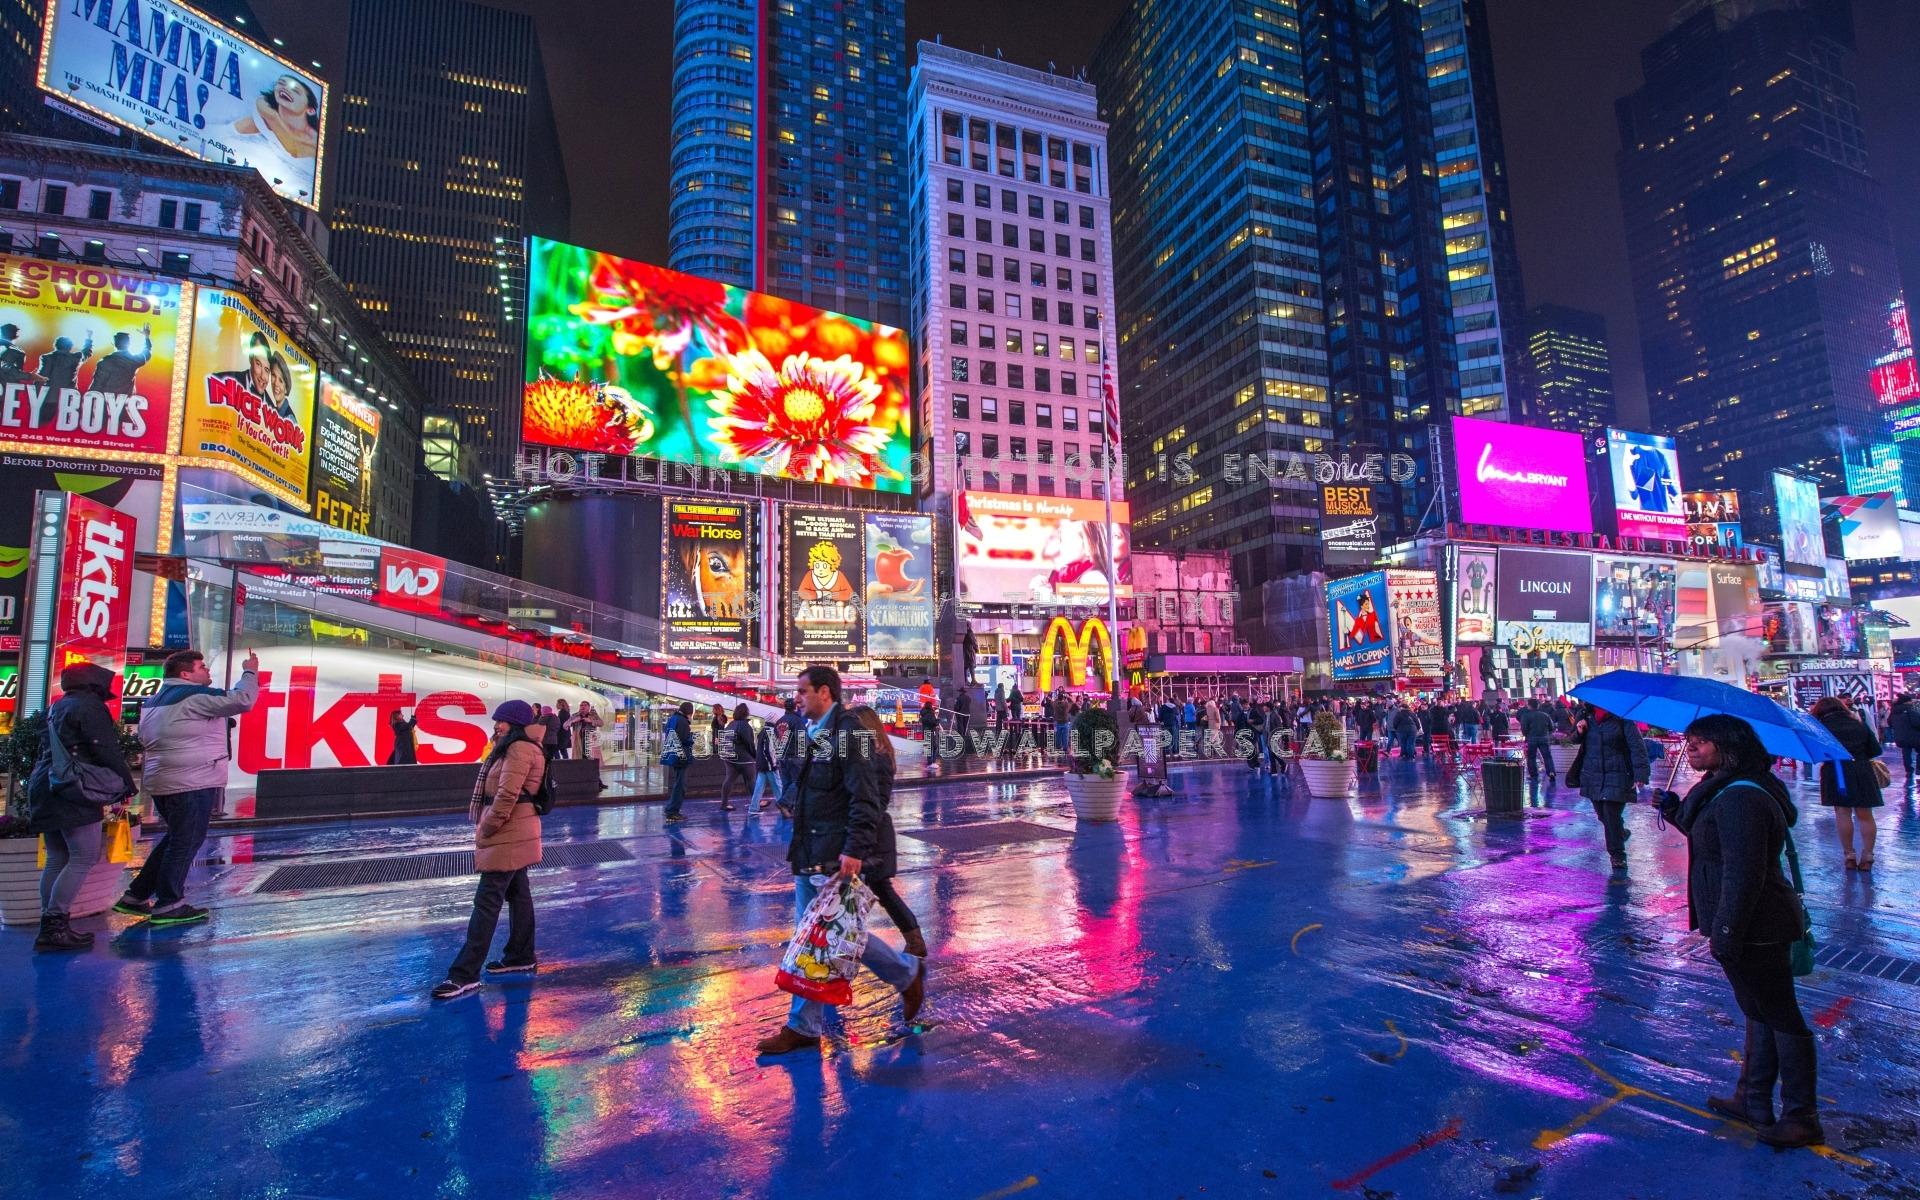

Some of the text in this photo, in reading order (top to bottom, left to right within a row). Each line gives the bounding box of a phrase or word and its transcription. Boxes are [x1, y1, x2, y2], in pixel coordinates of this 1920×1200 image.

[72, 0, 244, 100] MAMMA
[106, 40, 210, 129] MIA!
[64, 71, 177, 129] THE SMASH HIT MUSICAL
[18, 299, 40, 308] New
[64, 306, 90, 314] Times
[210, 293, 279, 344] Matthew BRODERICK
[56, 387, 149, 438] BOYS
[207, 376, 305, 454] NICE WORK
[340, 392, 375, 427] WINNER!
[46, 435, 71, 443] West
[74, 438, 101, 446] 52nd
[102, 440, 135, 448] Street
[245, 421, 258, 438] You
[258, 430, 271, 447] Can
[320, 426, 361, 457] EXHILARATING
[342, 426, 358, 443] MOST
[318, 448, 359, 476] STORYTELLING
[323, 438, 357, 463] BROADWAY
[321, 460, 328, 471] IN
[252, 462, 276, 481] FUNNIEST
[276, 475, 288, 488] LOVE
[287, 481, 302, 495] STORY
[1526, 472, 1568, 487] BRYANT
[1324, 487, 1371, 502] BEST
[1325, 501, 1372, 511] MUSICAL
[316, 489, 370, 536] PETER
[1683, 501, 1735, 516] LIVE
[1688, 536, 1715, 545] FOR
[77, 519, 125, 638] tkts
[1519, 579, 1572, 595] LINCOLN
[1716, 573, 1742, 585] Surface
[870, 610, 930, 628] SCANDALOUS
[1334, 646, 1390, 668] MARY POPPINS
[238, 665, 488, 775] tkts
